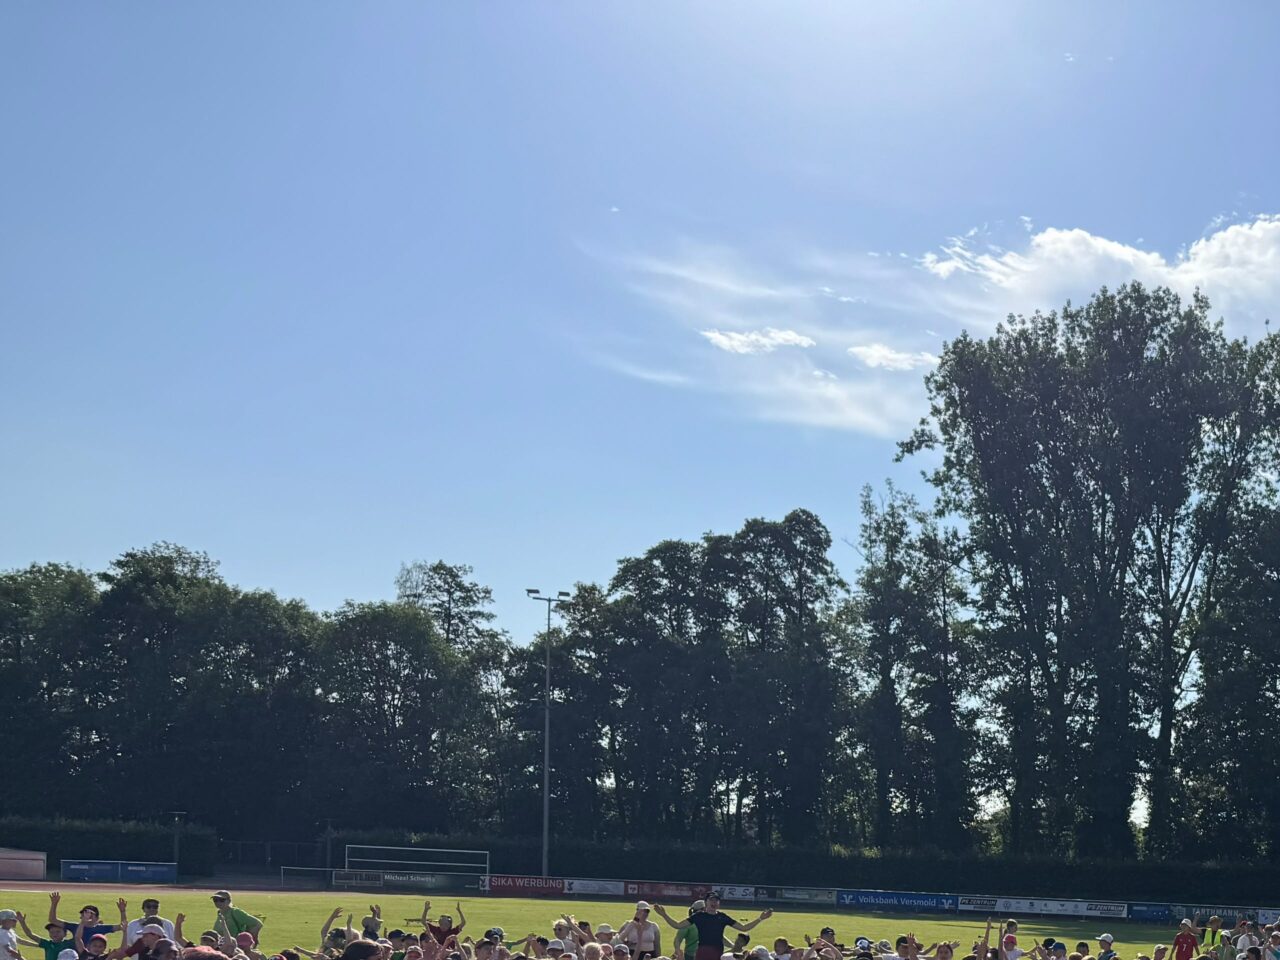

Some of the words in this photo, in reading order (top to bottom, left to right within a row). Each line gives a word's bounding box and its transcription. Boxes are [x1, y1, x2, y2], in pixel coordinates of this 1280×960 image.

[491, 877, 513, 887] SIKA
[515, 878, 563, 889] WERBUNG
[858, 895, 898, 905] Volksbank
[900, 898, 936, 907] Versmold
